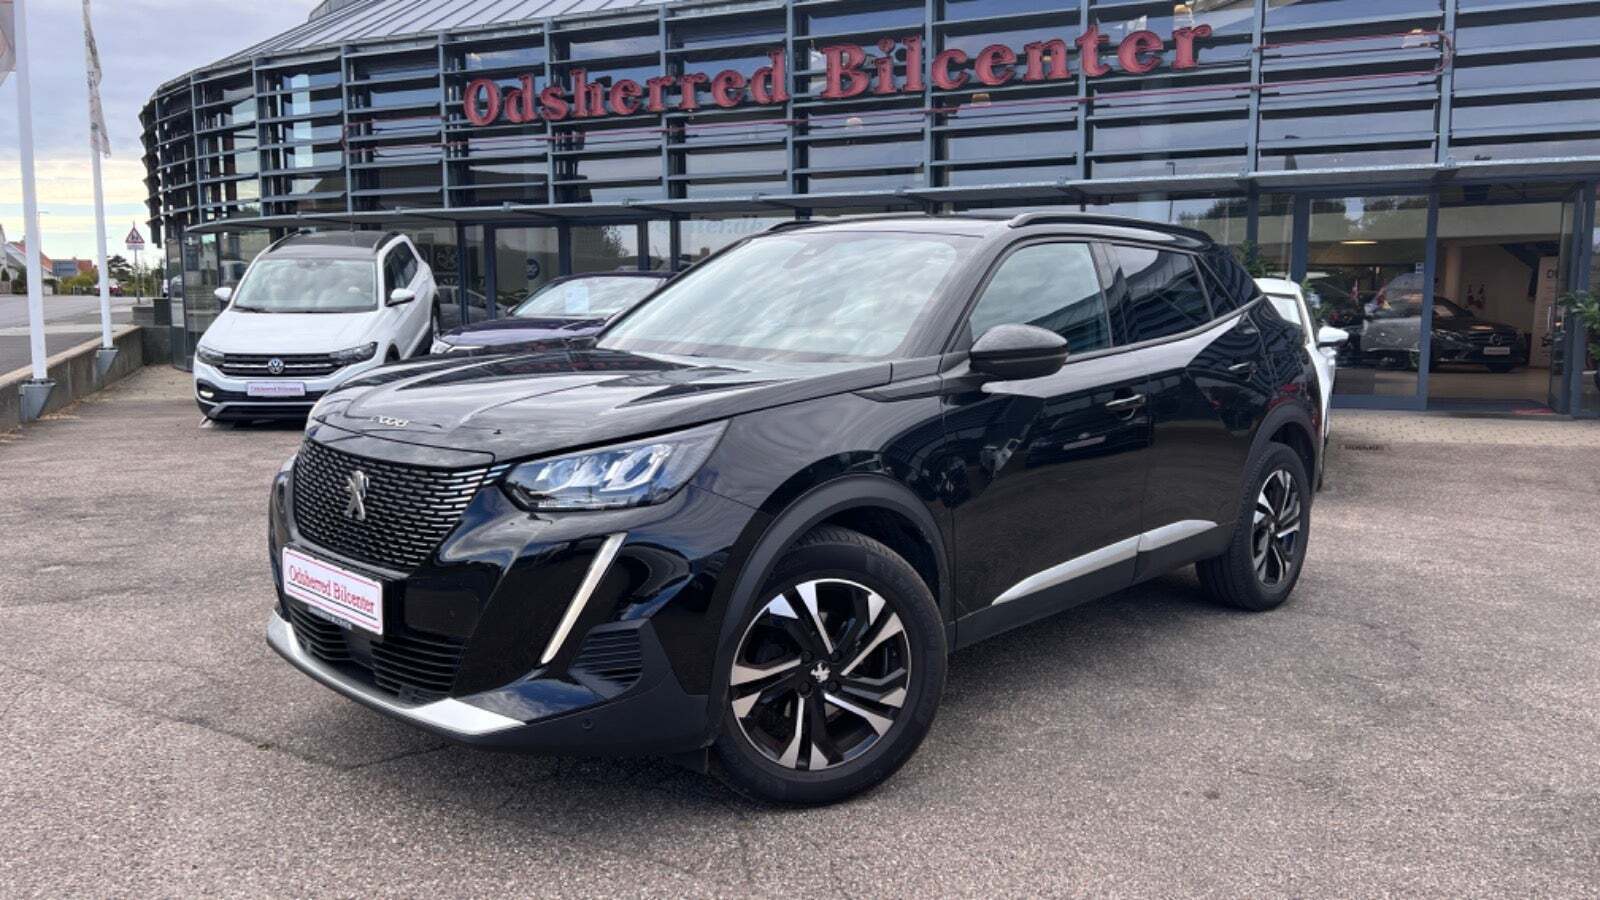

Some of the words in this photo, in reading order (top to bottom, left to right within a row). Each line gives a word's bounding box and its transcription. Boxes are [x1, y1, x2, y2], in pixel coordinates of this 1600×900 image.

[463, 50, 789, 126] Odsherred
[820, 24, 1212, 99] Bilcenter
[290, 565, 331, 597] Odsherred
[333, 582, 375, 615] Bilcenter
